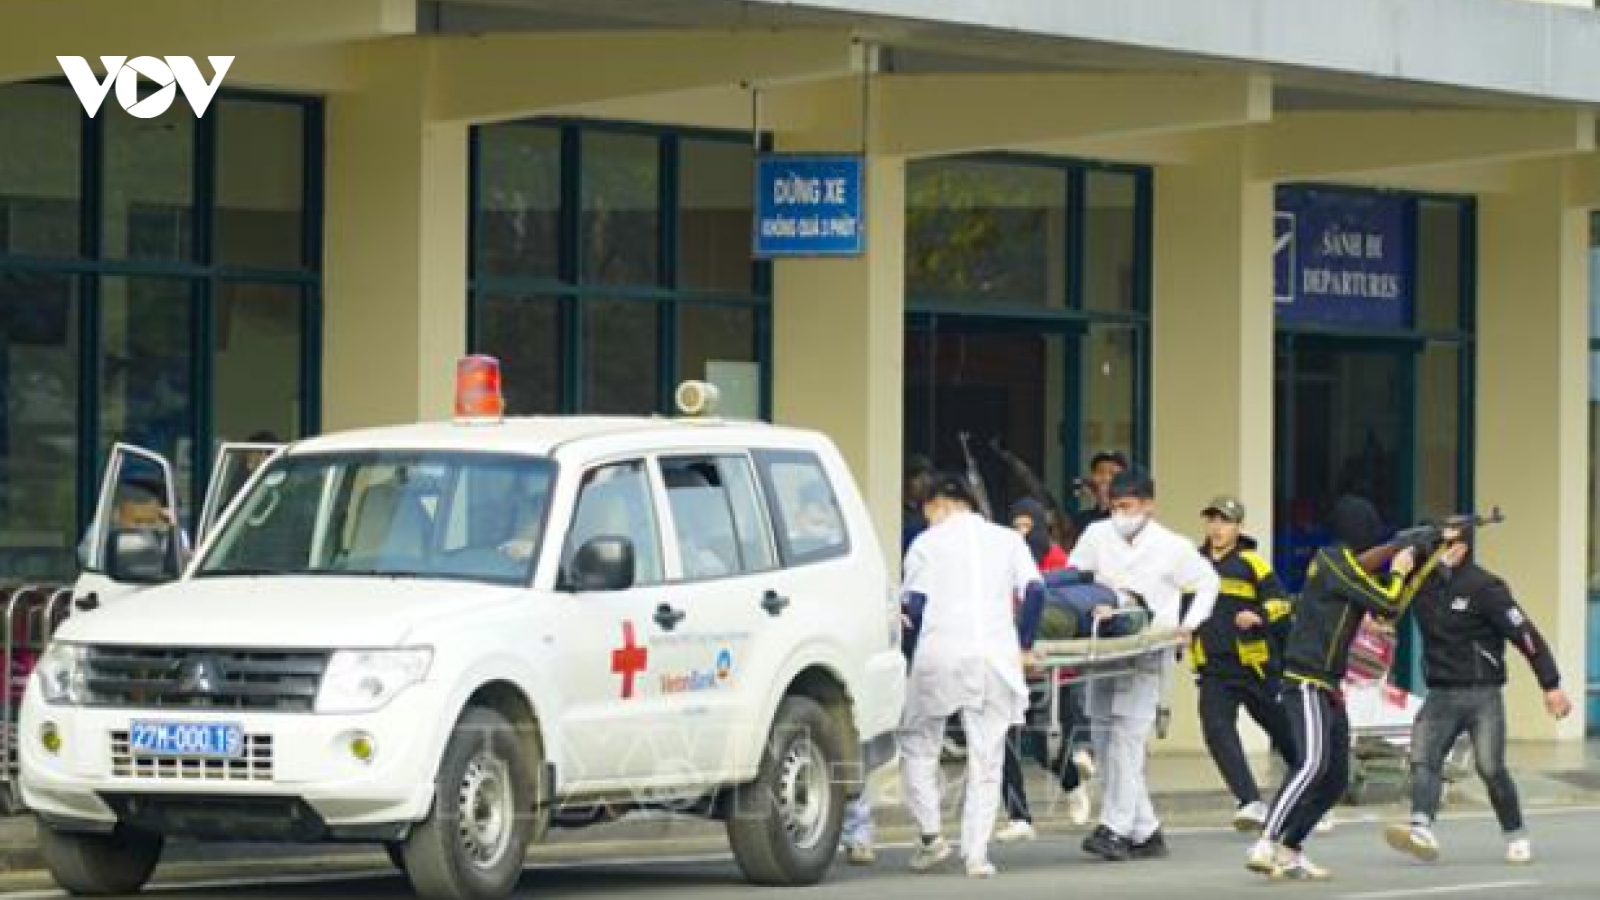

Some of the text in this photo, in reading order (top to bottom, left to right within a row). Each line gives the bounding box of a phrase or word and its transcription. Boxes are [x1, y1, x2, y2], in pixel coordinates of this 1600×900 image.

[773, 171, 845, 205] DỪNG XE
[1303, 268, 1398, 299] DEPARTURES
